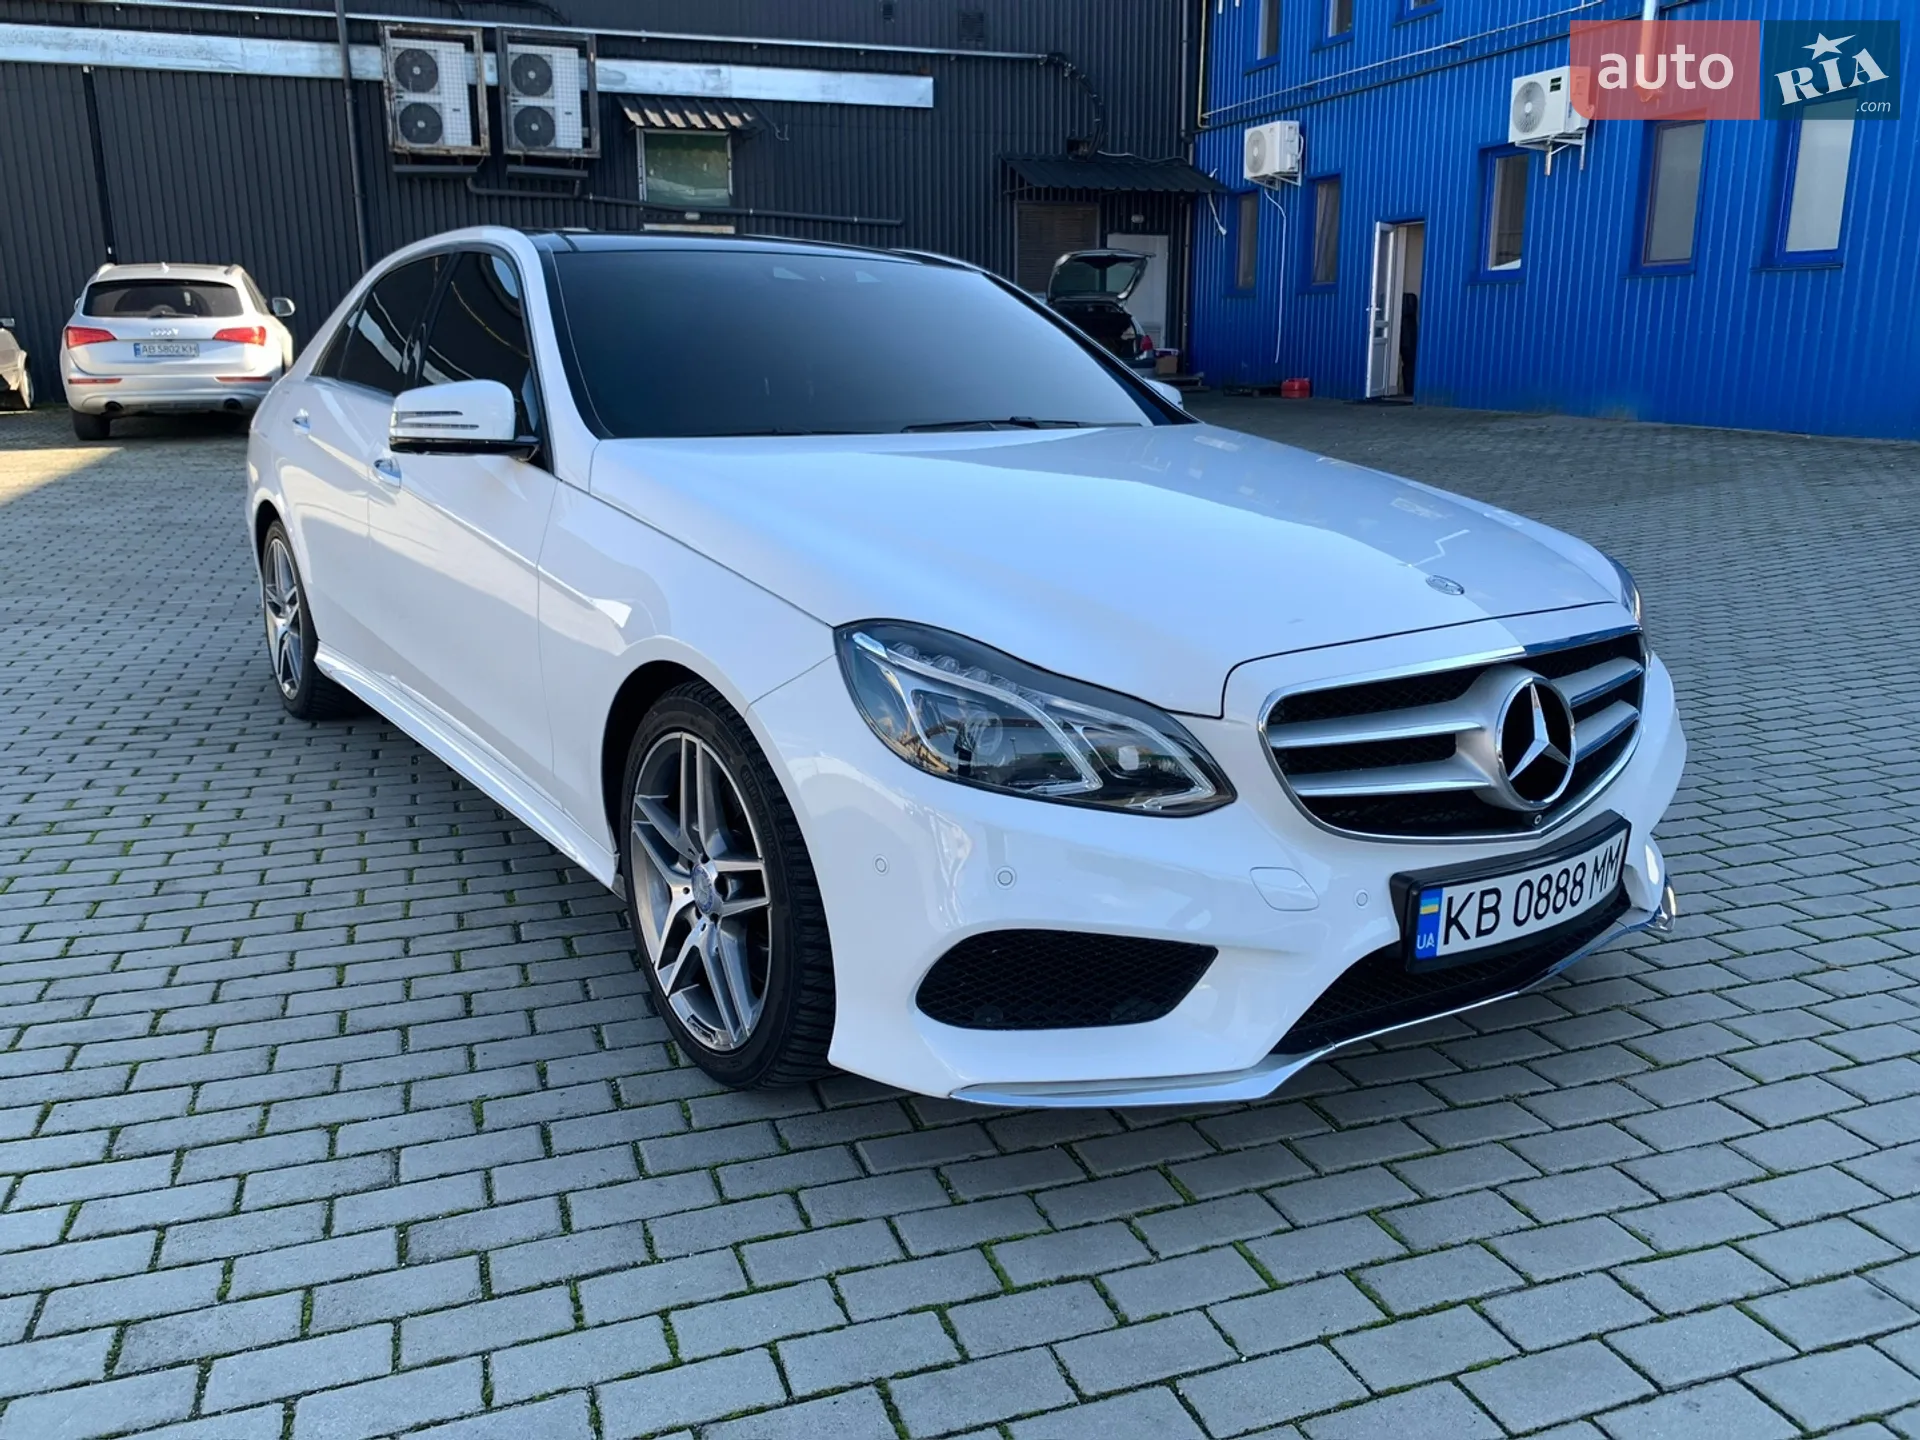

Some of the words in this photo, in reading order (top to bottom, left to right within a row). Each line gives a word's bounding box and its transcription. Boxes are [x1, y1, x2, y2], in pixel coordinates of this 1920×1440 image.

[1443, 887, 1504, 946] KB
[1512, 861, 1587, 928] 0888
[1588, 838, 1624, 900] MM
[1416, 931, 1436, 950] UA
